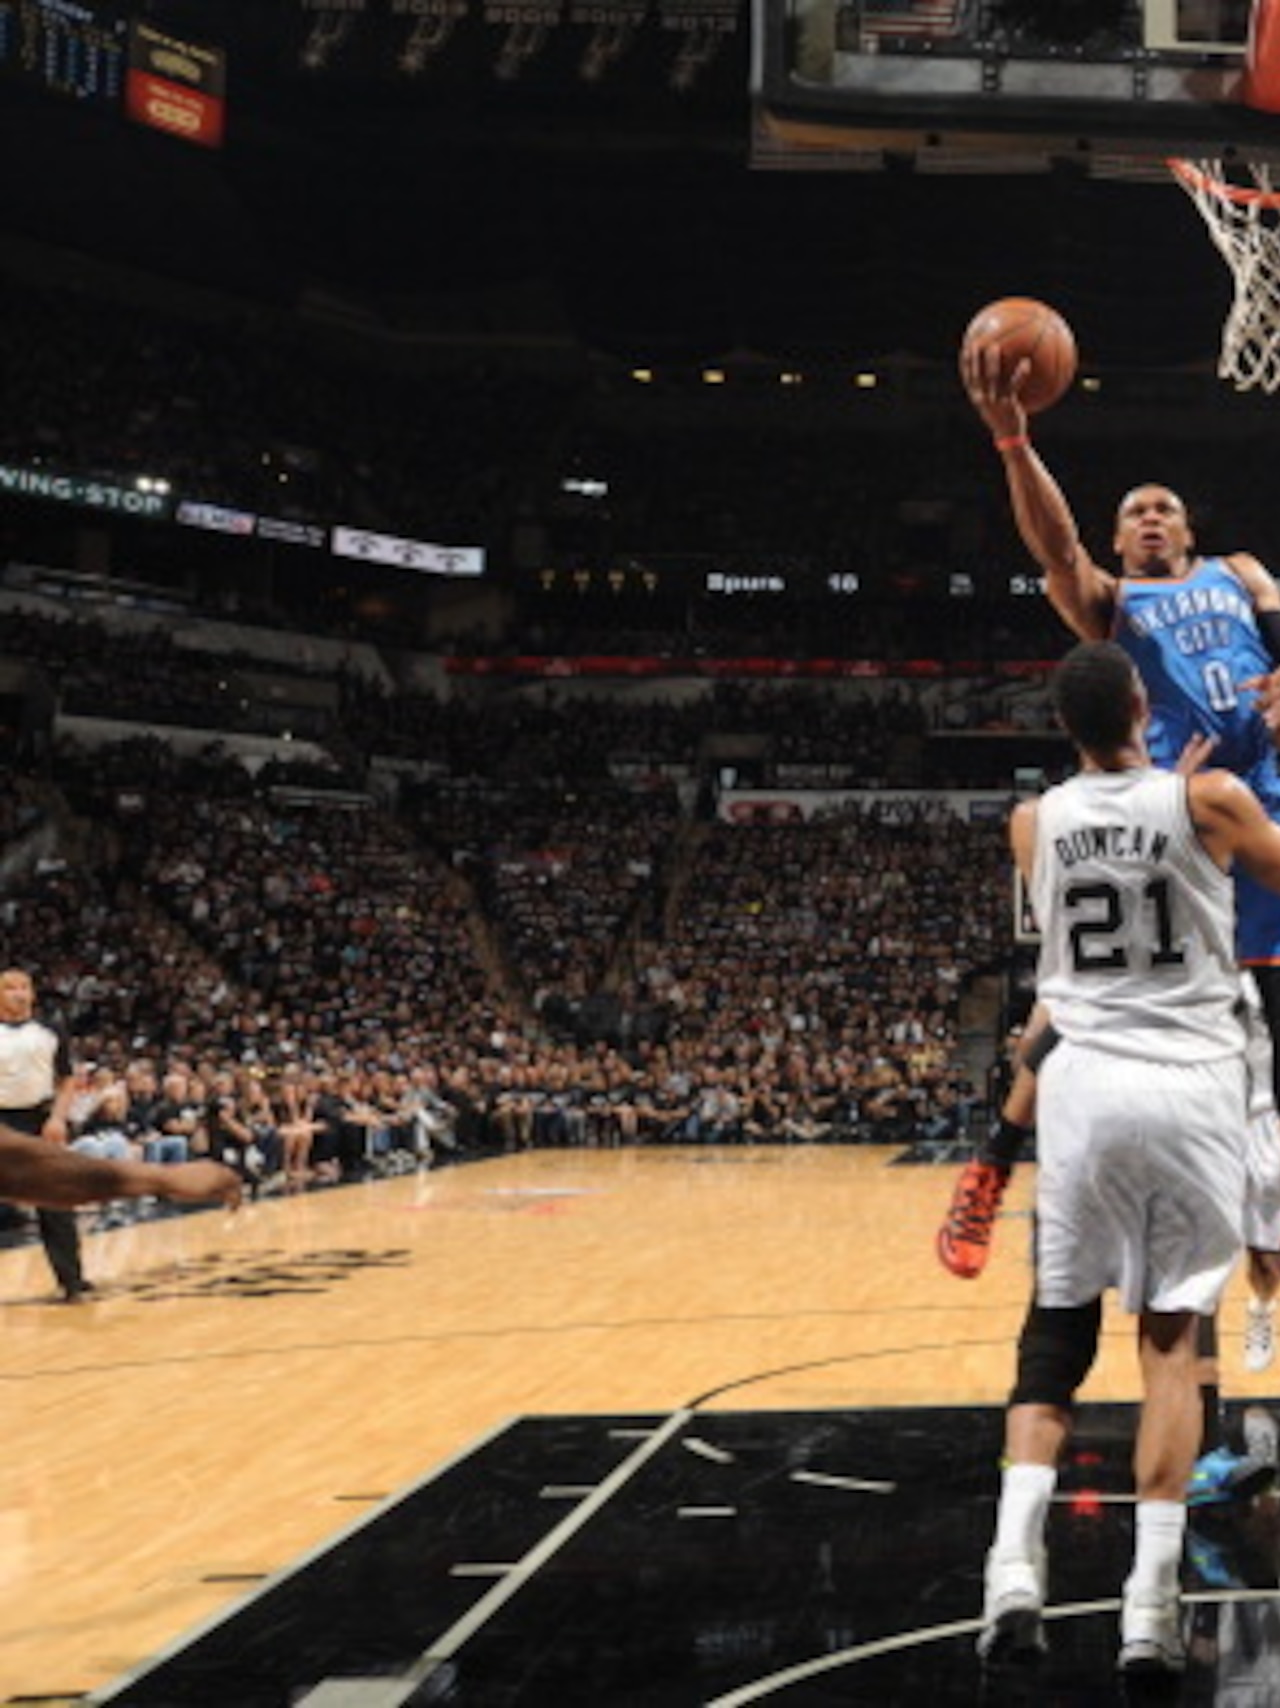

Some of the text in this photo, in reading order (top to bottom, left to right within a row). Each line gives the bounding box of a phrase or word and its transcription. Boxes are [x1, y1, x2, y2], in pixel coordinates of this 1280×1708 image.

[1174, 619, 1232, 656] CITY
[1202, 659, 1239, 713] 0
[1054, 825, 1170, 867] DUNCAN
[1065, 877, 1186, 972] 21
